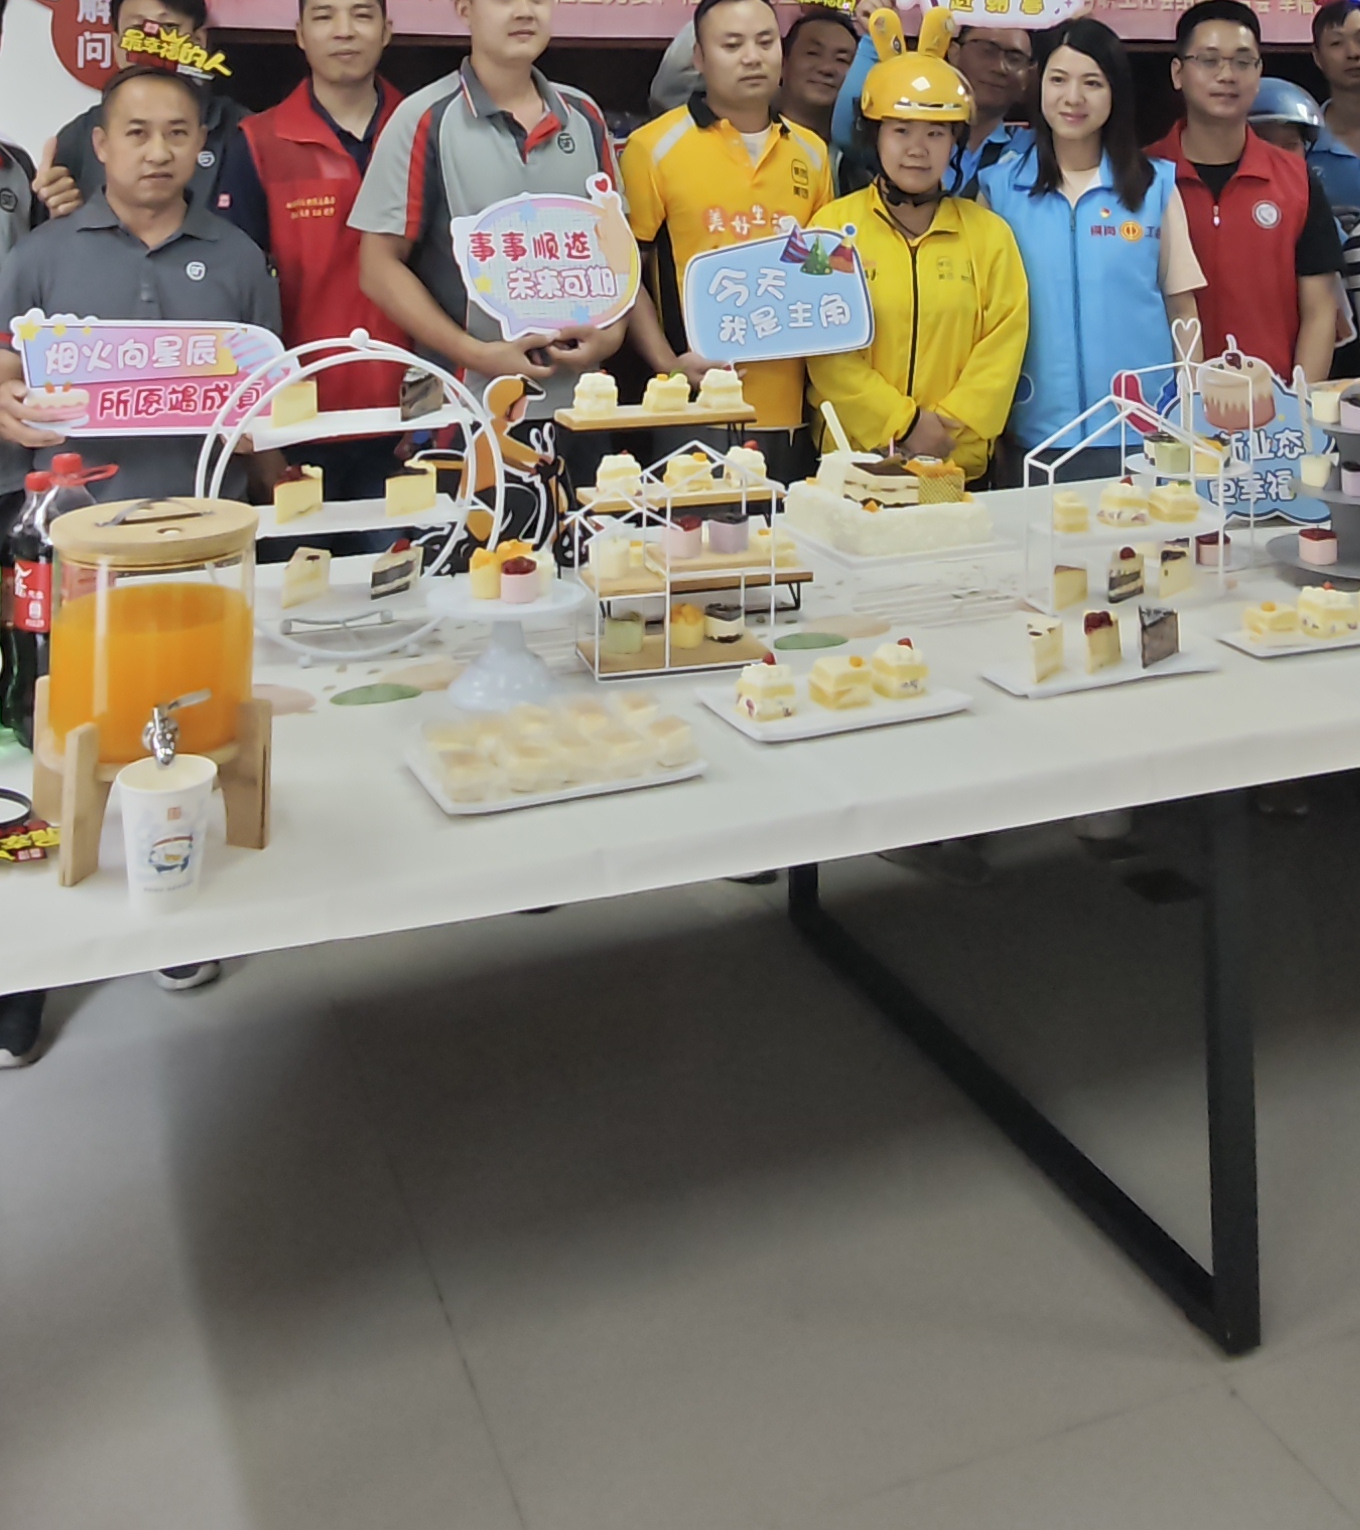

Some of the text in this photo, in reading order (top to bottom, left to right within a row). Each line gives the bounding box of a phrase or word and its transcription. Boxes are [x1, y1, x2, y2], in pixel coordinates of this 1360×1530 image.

[120, 28, 233, 77] 最幸福的人
[469, 231, 592, 263] 事事顺遂
[508, 266, 618, 301] 未来可期
[708, 267, 787, 308] 今天
[718, 293, 852, 346] 我是主角
[44, 334, 219, 375] 烟火向星辰
